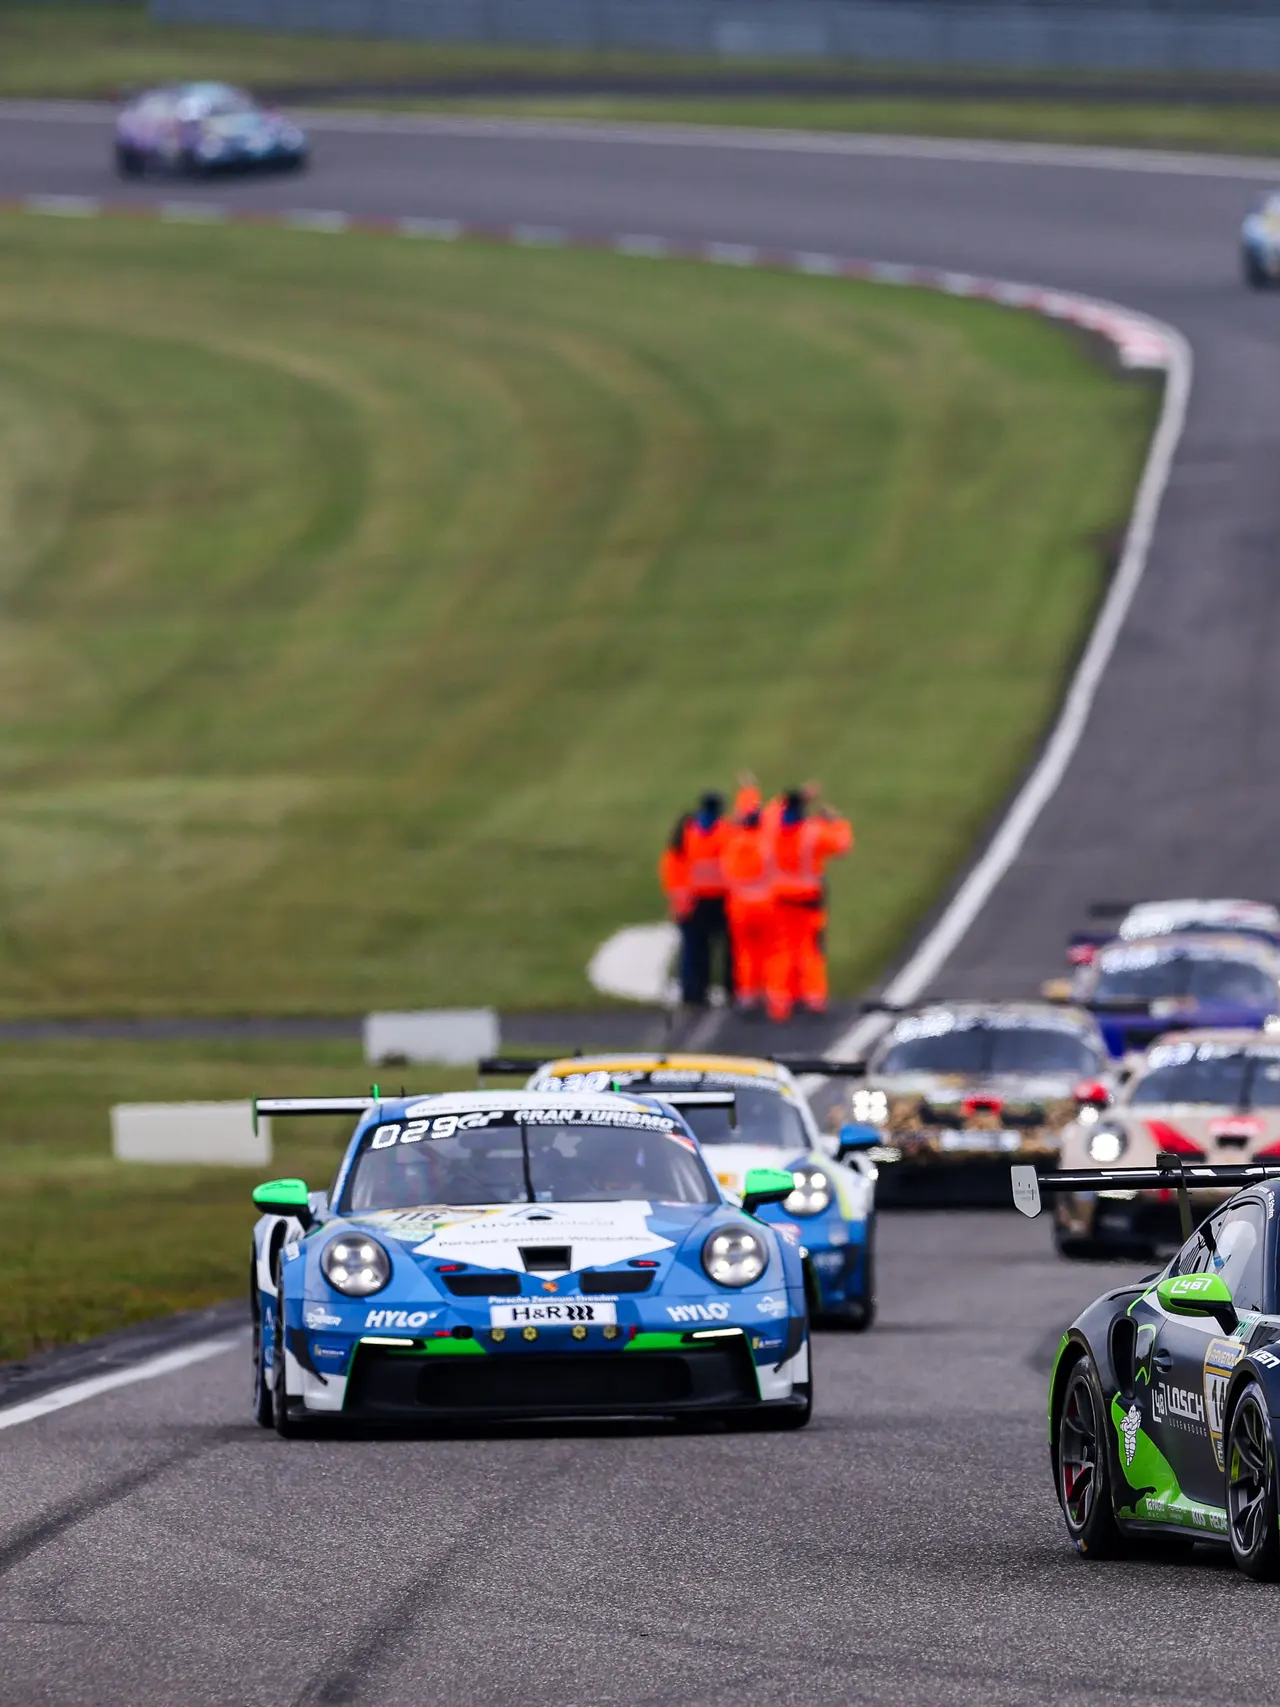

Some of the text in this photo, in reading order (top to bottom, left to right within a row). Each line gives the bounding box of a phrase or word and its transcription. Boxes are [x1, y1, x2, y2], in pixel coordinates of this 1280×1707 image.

[513, 1110, 577, 1122] GRAN
[579, 1111, 676, 1129] TURISMO
[371, 1114, 458, 1149] 029
[364, 1310, 429, 1328] HYLO
[666, 1302, 729, 1322] HYLO
[1166, 1384, 1205, 1422] LOSCH
[1168, 1416, 1208, 1437] LUXEMBOURG
